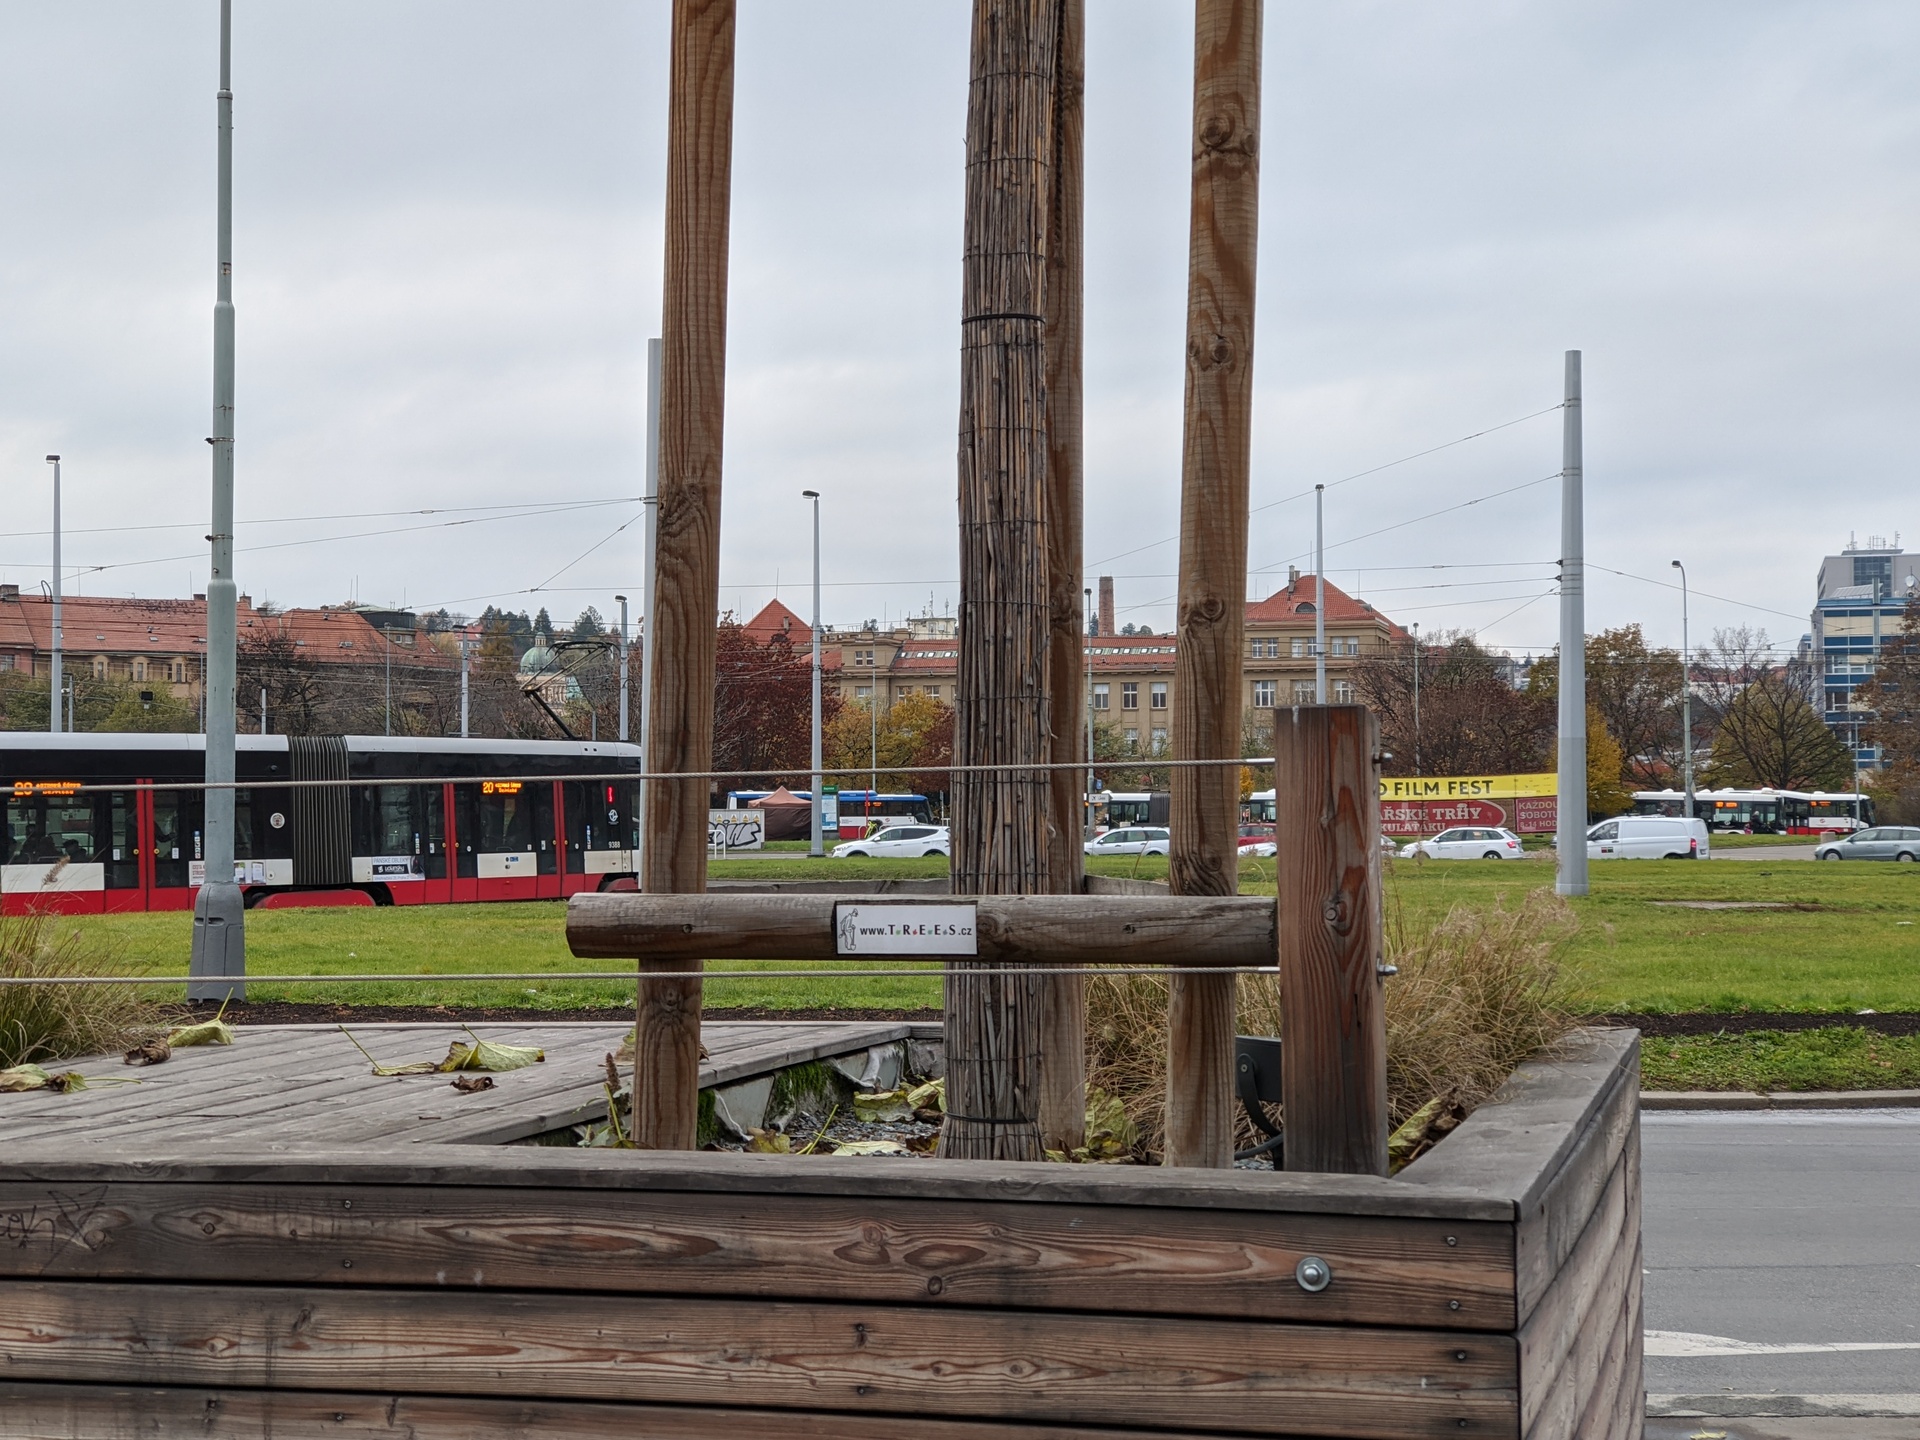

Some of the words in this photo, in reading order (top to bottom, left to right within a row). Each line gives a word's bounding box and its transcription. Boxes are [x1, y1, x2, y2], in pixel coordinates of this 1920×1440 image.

[483, 781, 494, 793] 20
[1394, 781, 1440, 796] FILM
[1447, 779, 1494, 795] FEST
[1380, 805, 1429, 820] ŘSKÉ
[1432, 806, 1482, 820] TRHY
[608, 840, 621, 849] 9388
